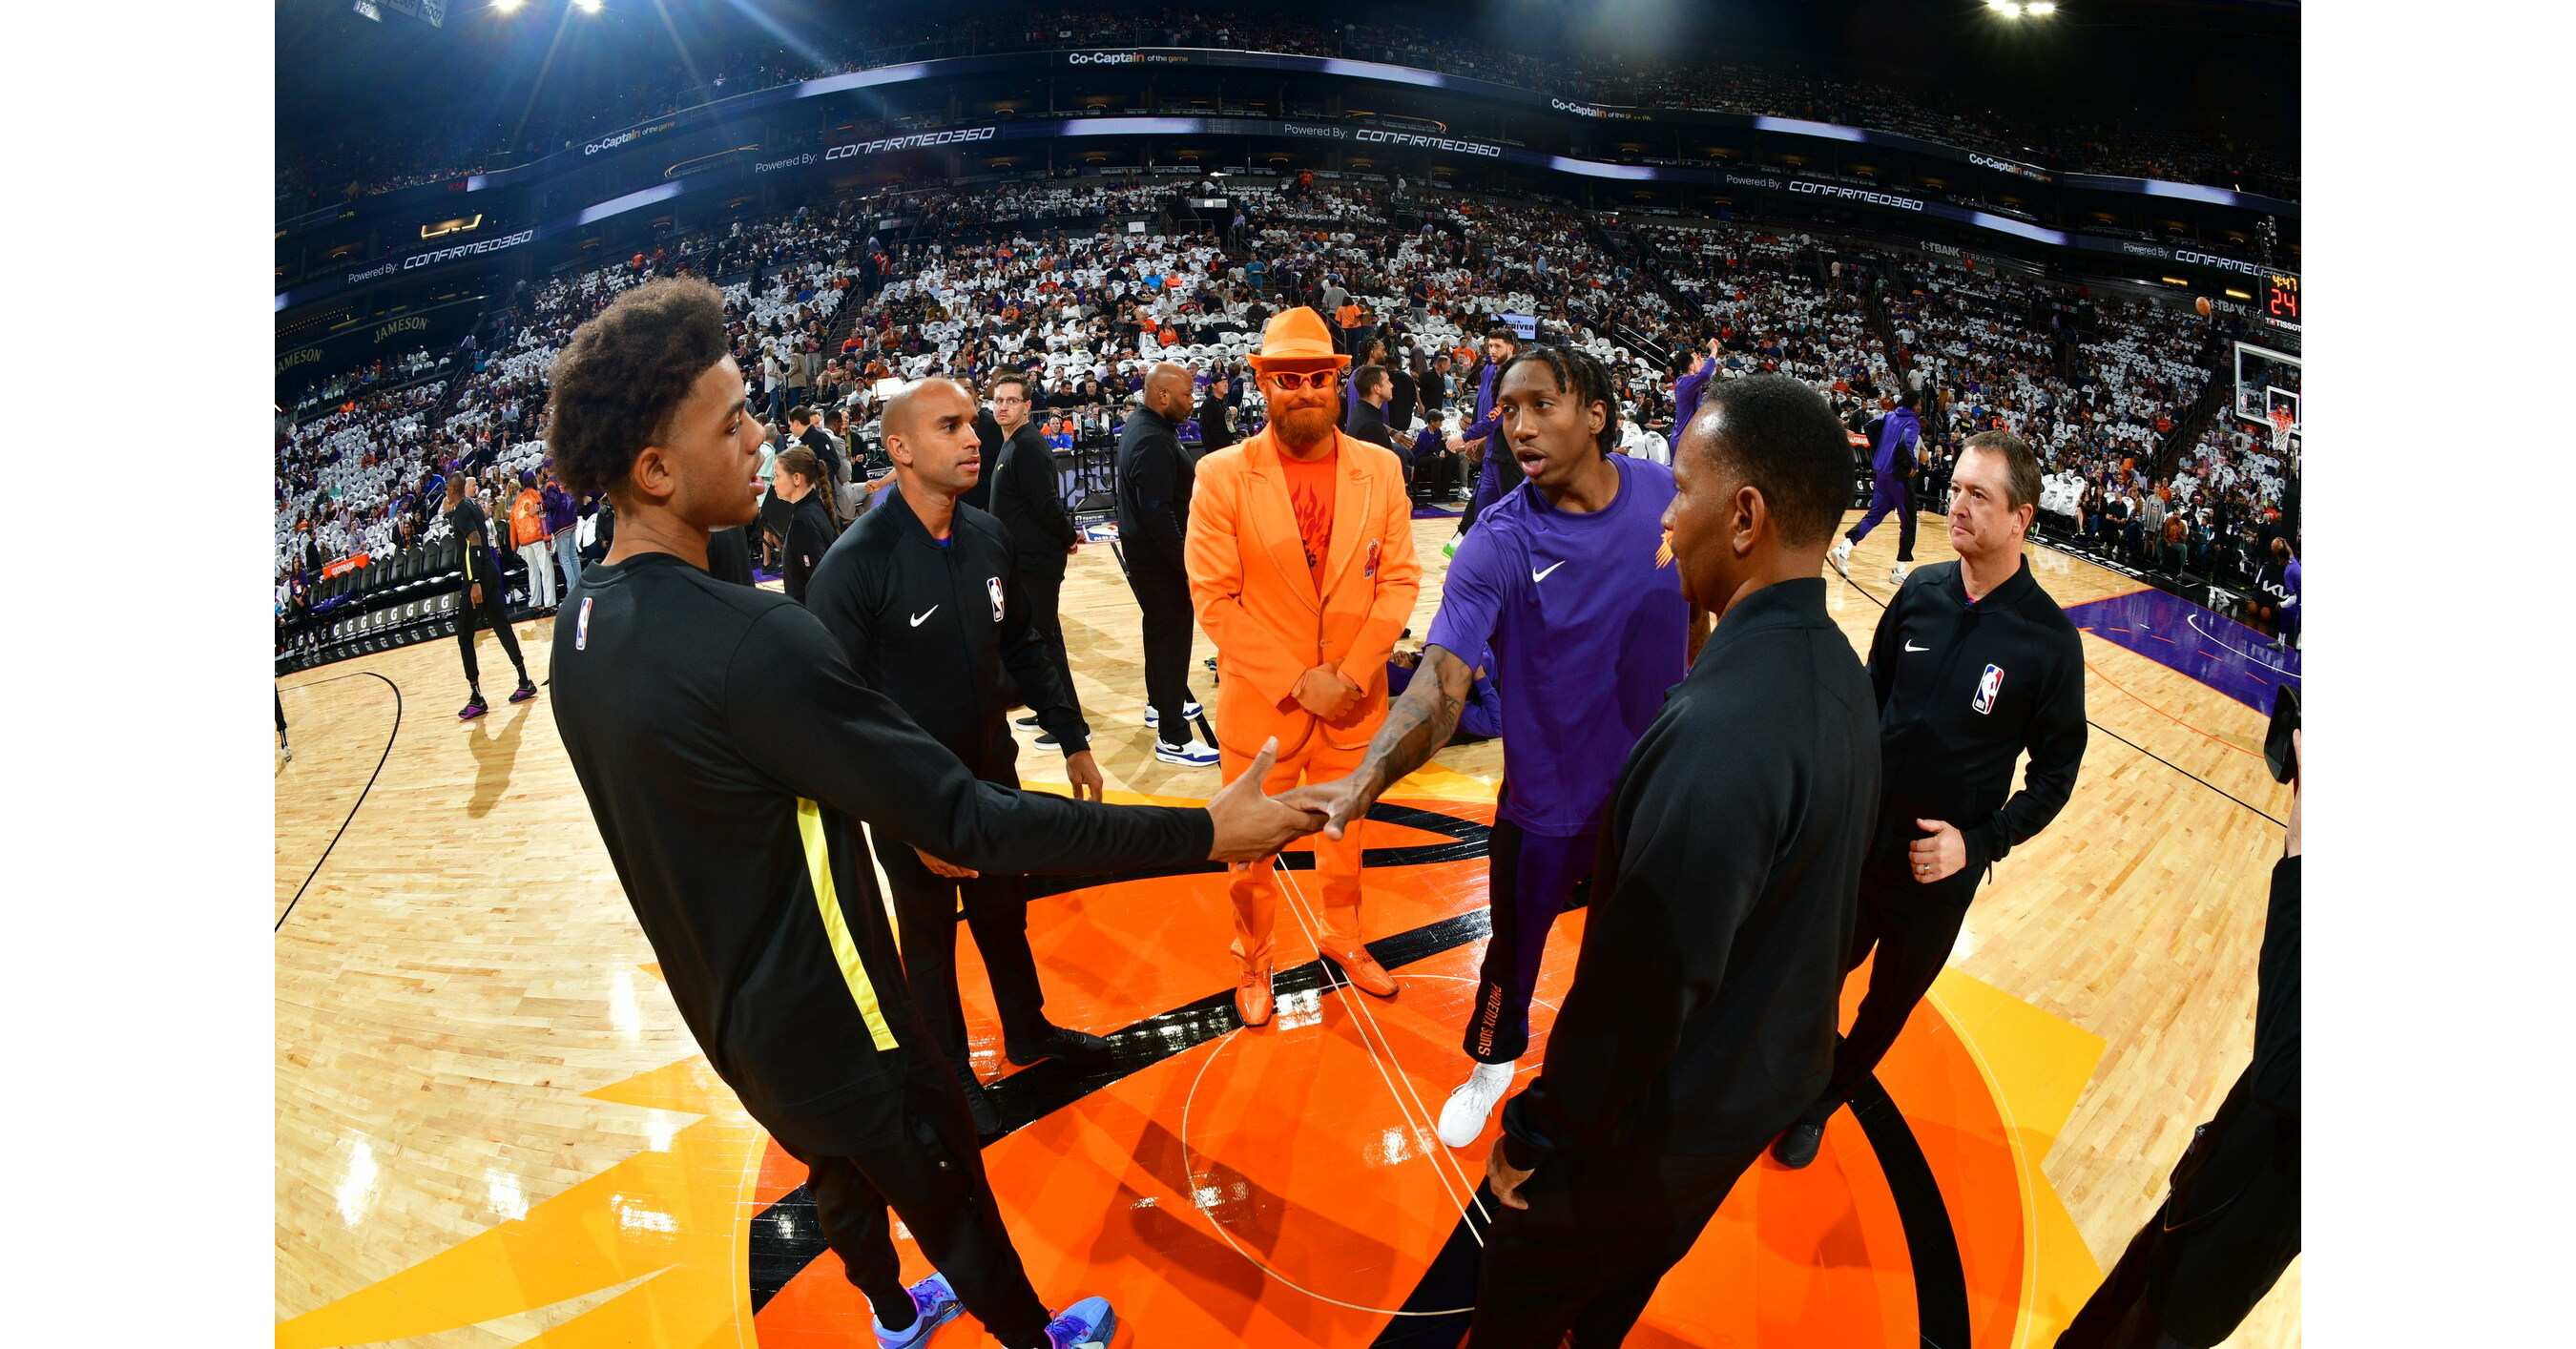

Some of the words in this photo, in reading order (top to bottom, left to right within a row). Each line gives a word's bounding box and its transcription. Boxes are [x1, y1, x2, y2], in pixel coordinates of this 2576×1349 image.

[1069, 52, 1145, 65] Co-Captain
[1551, 97, 1607, 118] Co-Captain
[585, 130, 641, 156] Co-Captain
[642, 127, 649, 135] of
[1284, 123, 1330, 136] Powered
[1333, 127, 1348, 139] By:
[1355, 129, 1502, 157] CONFIRMED360
[756, 156, 800, 174] Powered
[801, 153, 818, 166] By:
[824, 127, 996, 160] CONFIRMED360
[1969, 154, 2023, 175] Co-Captain
[1726, 175, 1766, 187] Powered
[1769, 177, 1782, 190] By:
[1789, 181, 1923, 212] CONFIRMED360
[348, 266, 384, 284] Powered
[385, 262, 399, 276] By:
[404, 230, 533, 269] CONFIRMED360
[2124, 242, 2157, 257] Powered
[2158, 248, 2171, 259] By:
[2272, 274, 2297, 292] 4:47
[2271, 288, 2296, 318] 24
[374, 317, 427, 344] JAMESON
[406, 604, 414, 616] G
[424, 600, 431, 612] G
[441, 595, 448, 609] G
[361, 616, 366, 629] G
[375, 612, 382, 624] G
[390, 608, 397, 620] G
[321, 628, 326, 640] G
[334, 624, 340, 636] G
[347, 620, 353, 633] G
[309, 633, 315, 644] G
[1483, 982, 1502, 1028] PHOENIX
[1478, 1027, 1494, 1056] SUNS
